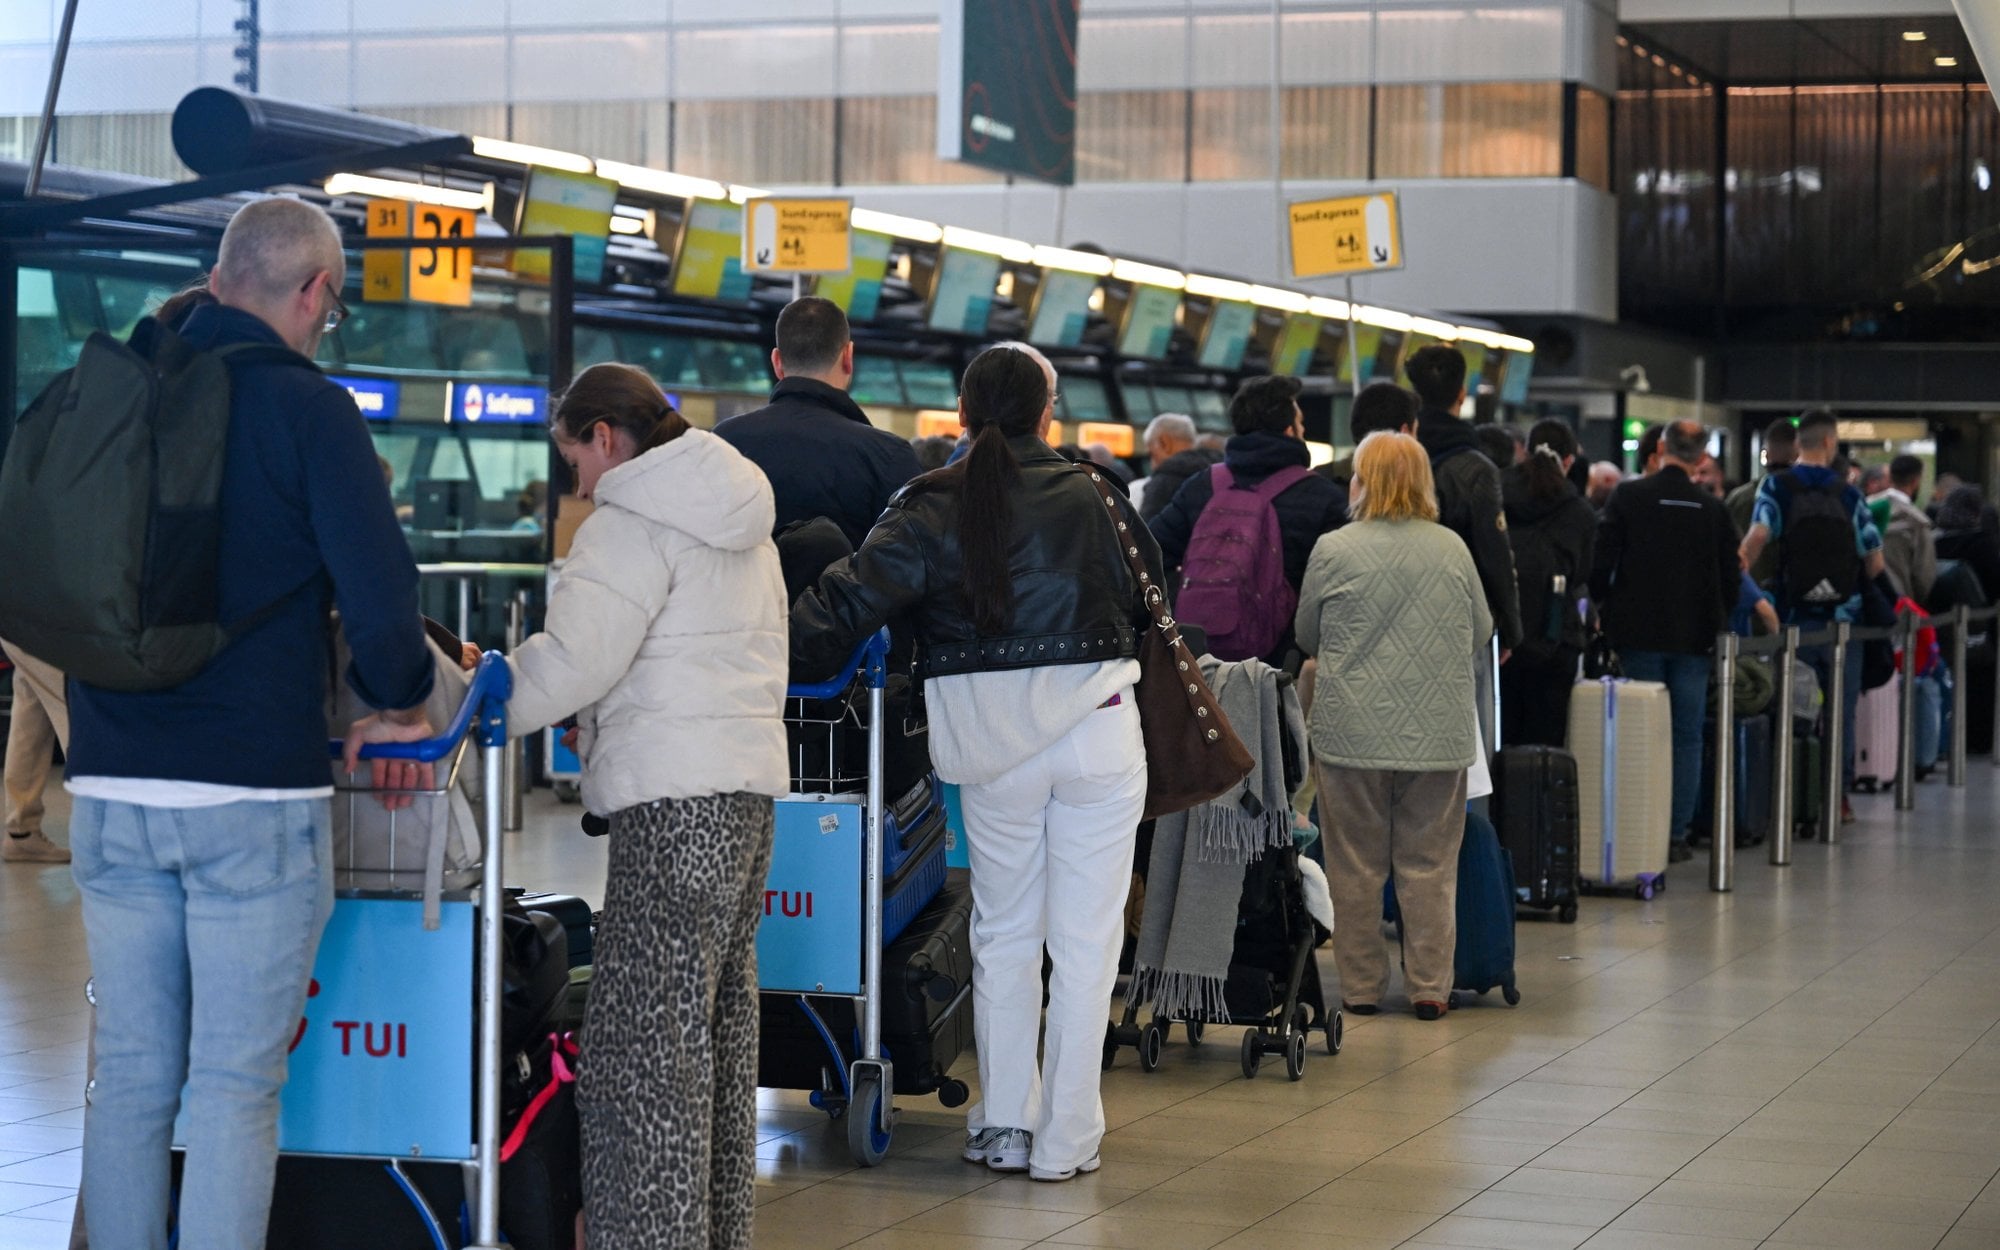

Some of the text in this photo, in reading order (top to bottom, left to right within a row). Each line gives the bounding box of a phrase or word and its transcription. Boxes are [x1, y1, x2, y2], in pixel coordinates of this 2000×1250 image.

[379, 209, 397, 226] 31
[419, 212, 462, 279] 31
[764, 890, 813, 918] TUI
[332, 1021, 406, 1058] TUI
